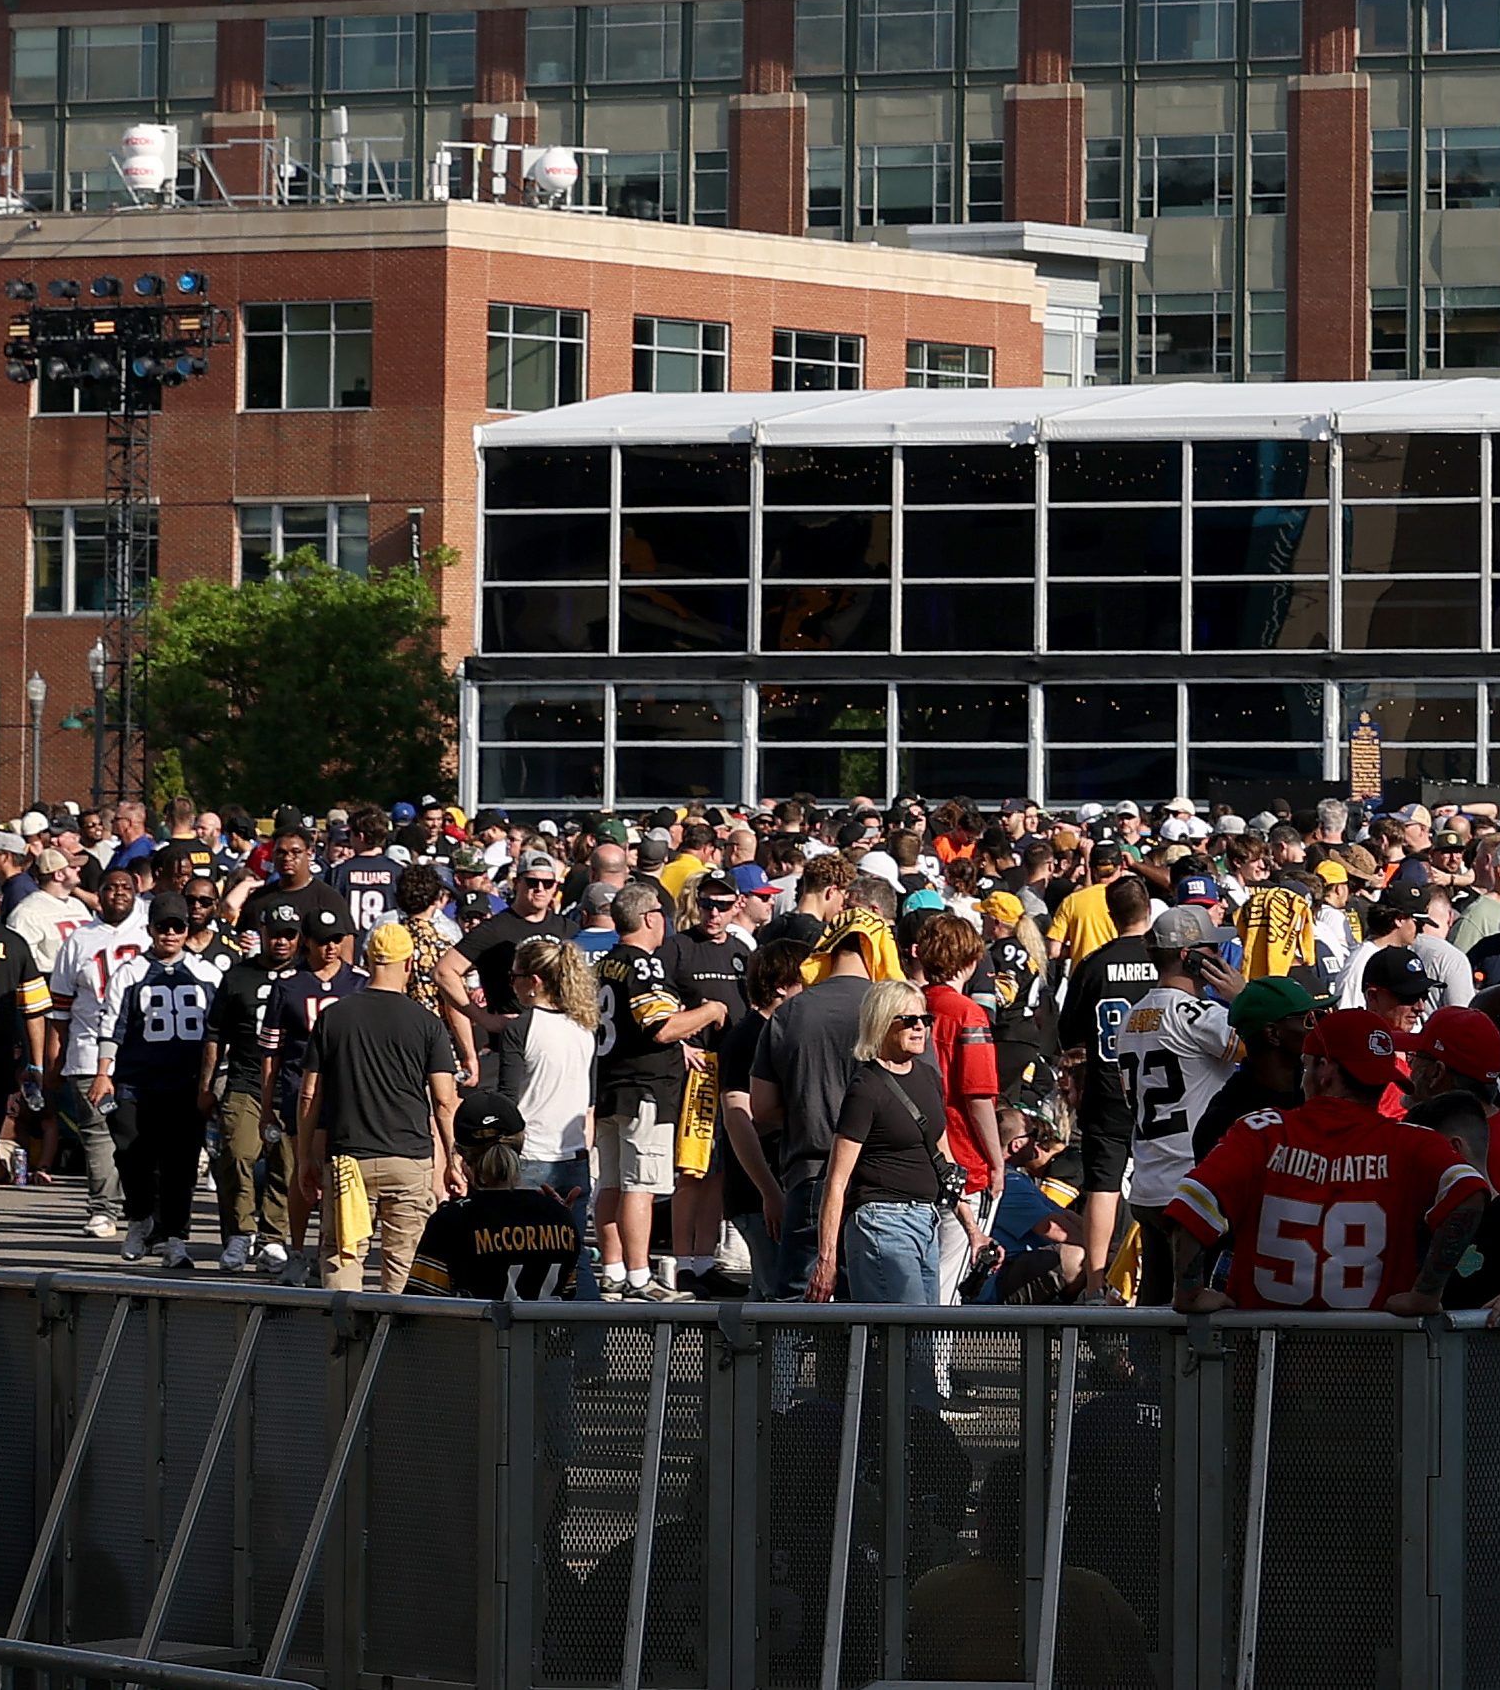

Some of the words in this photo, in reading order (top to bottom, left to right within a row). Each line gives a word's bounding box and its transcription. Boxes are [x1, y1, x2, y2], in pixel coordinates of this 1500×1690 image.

[348, 870, 393, 886] WILLIAMS
[632, 957, 666, 981] 33
[142, 984, 205, 1042] 88
[1093, 997, 1134, 1063] 8
[1264, 1142, 1329, 1186] RAIDER
[1328, 1152, 1389, 1183] HATER
[1253, 1192, 1388, 1309] 58
